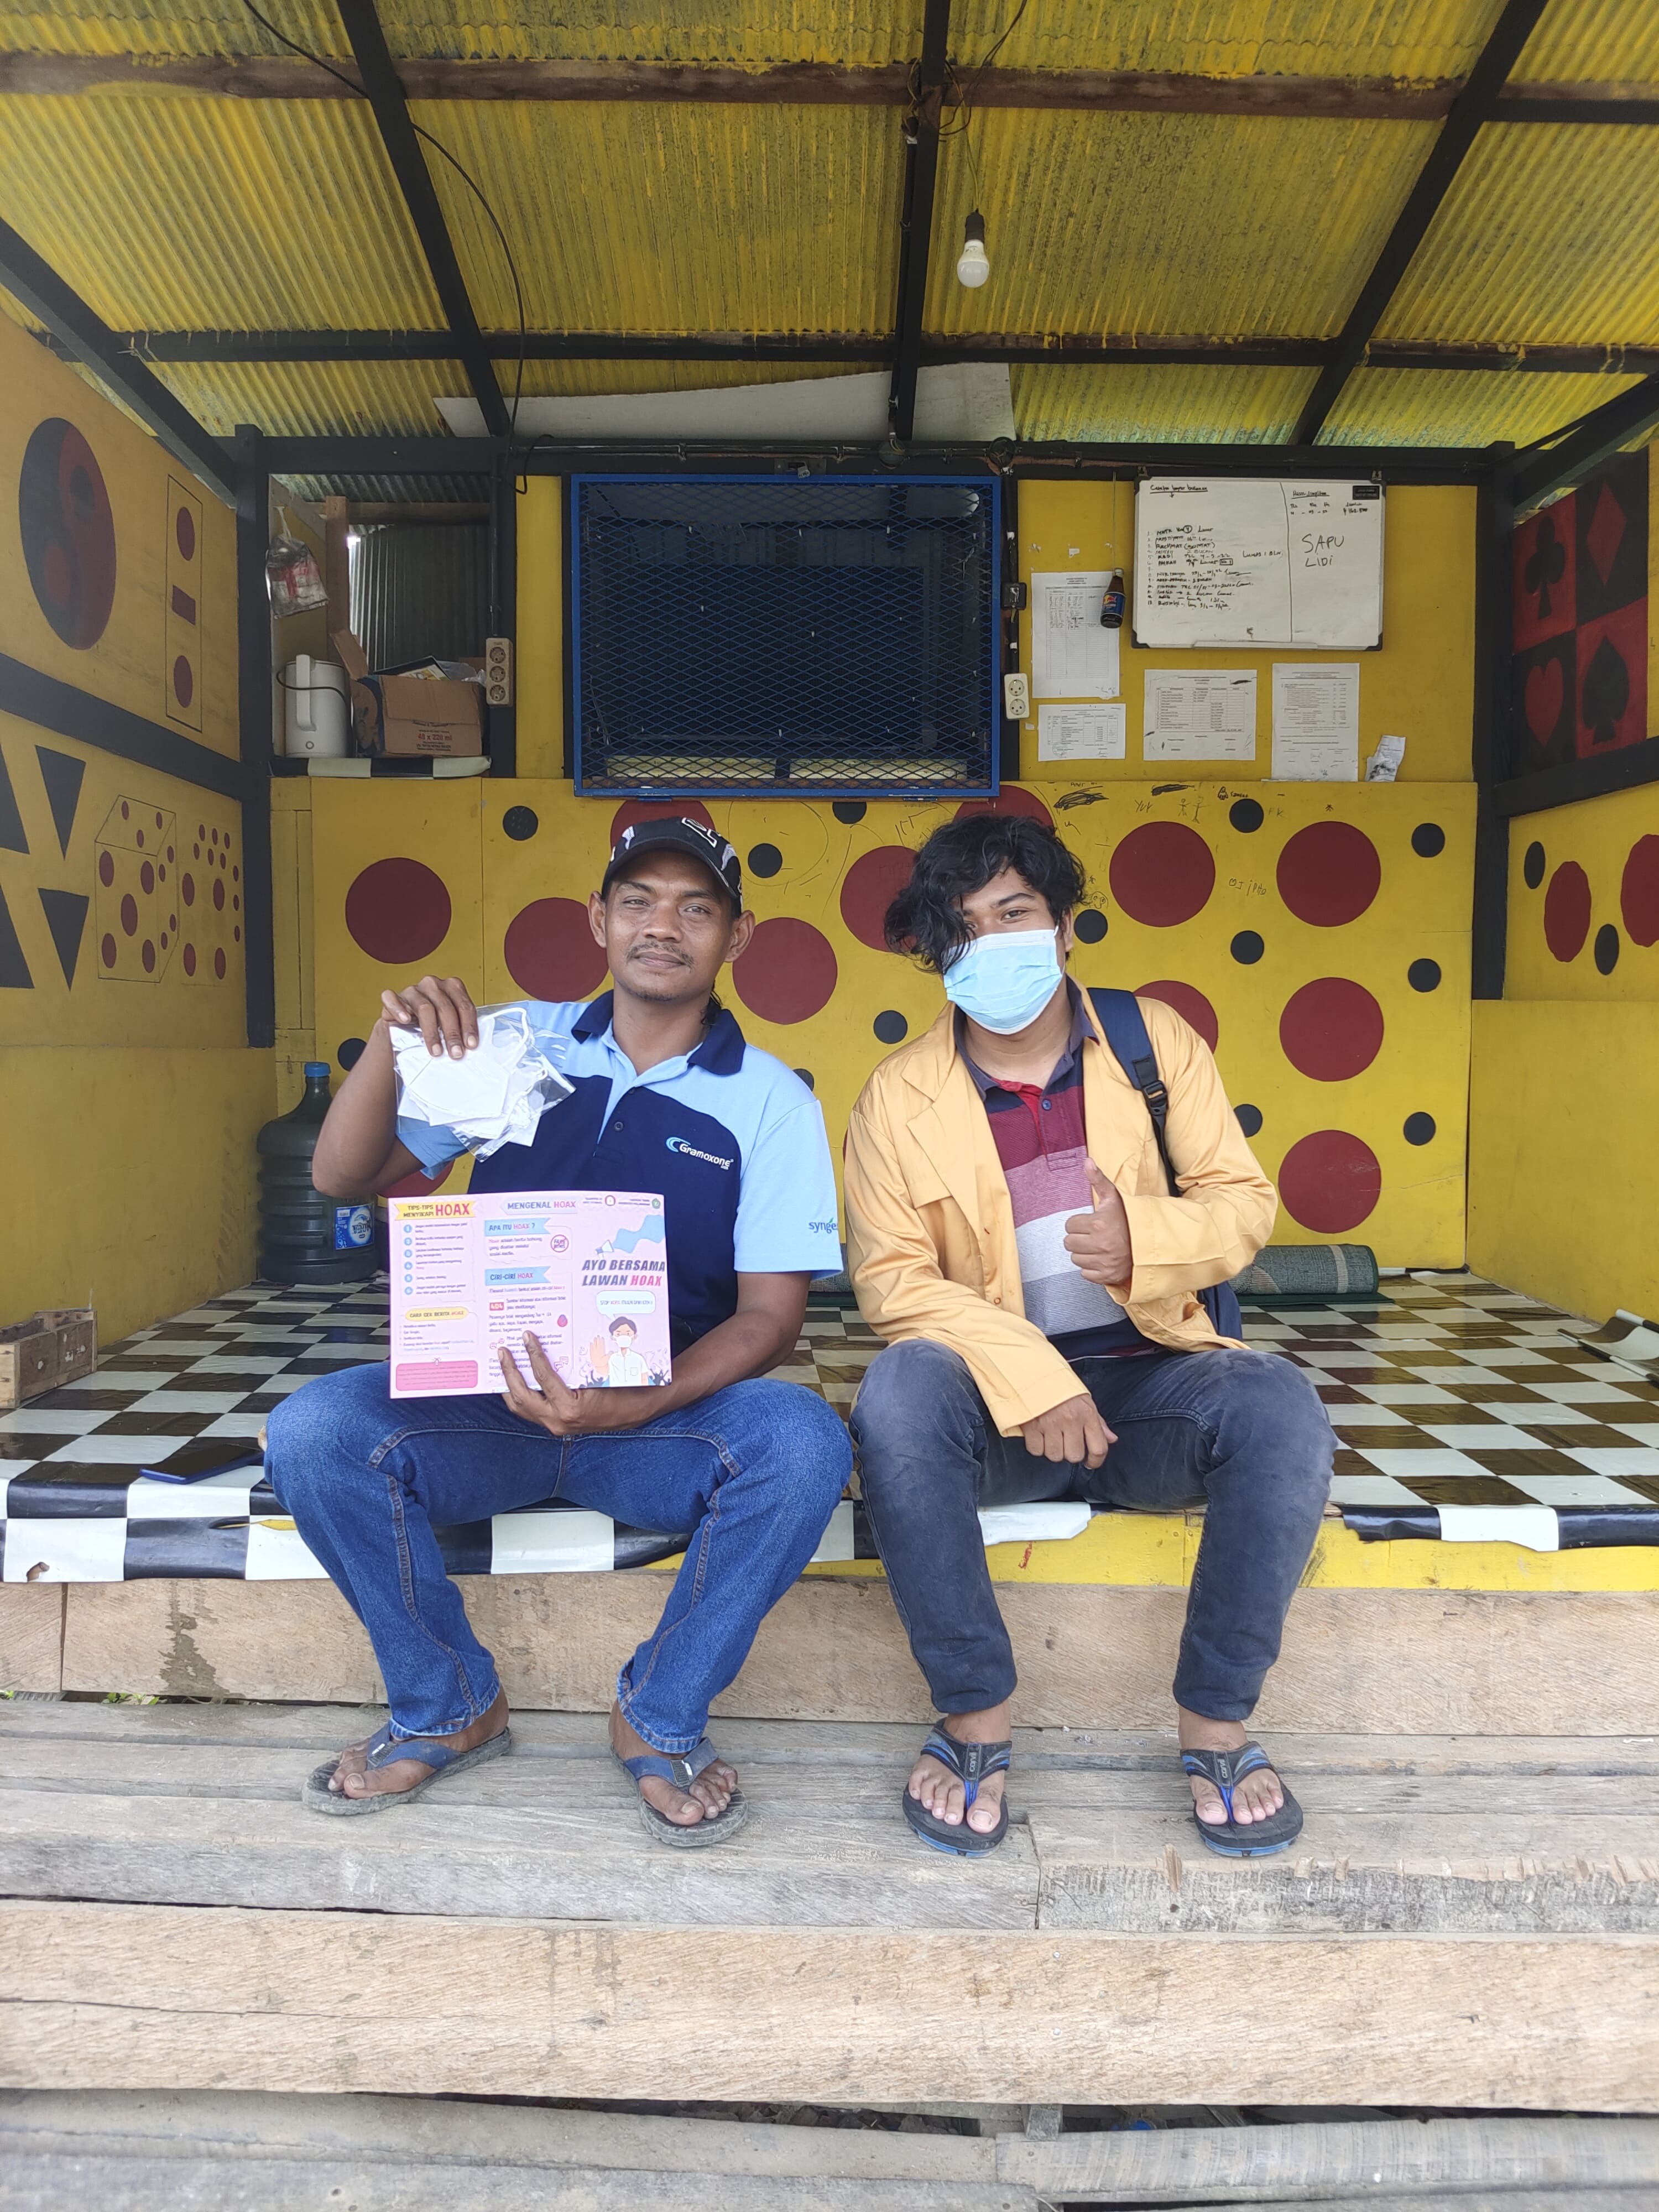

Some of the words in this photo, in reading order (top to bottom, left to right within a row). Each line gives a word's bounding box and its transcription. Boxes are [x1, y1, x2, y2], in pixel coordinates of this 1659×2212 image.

[1302, 534, 1344, 554] SAPU
[435, 1203, 469, 1216] HOAX
[808, 1222, 838, 1234] synge
[582, 1260, 607, 1271] AYO
[609, 1260, 665, 1272] BERSAMA
[582, 1275, 628, 1286] LAWAN
[630, 1275, 662, 1286] HOAX
